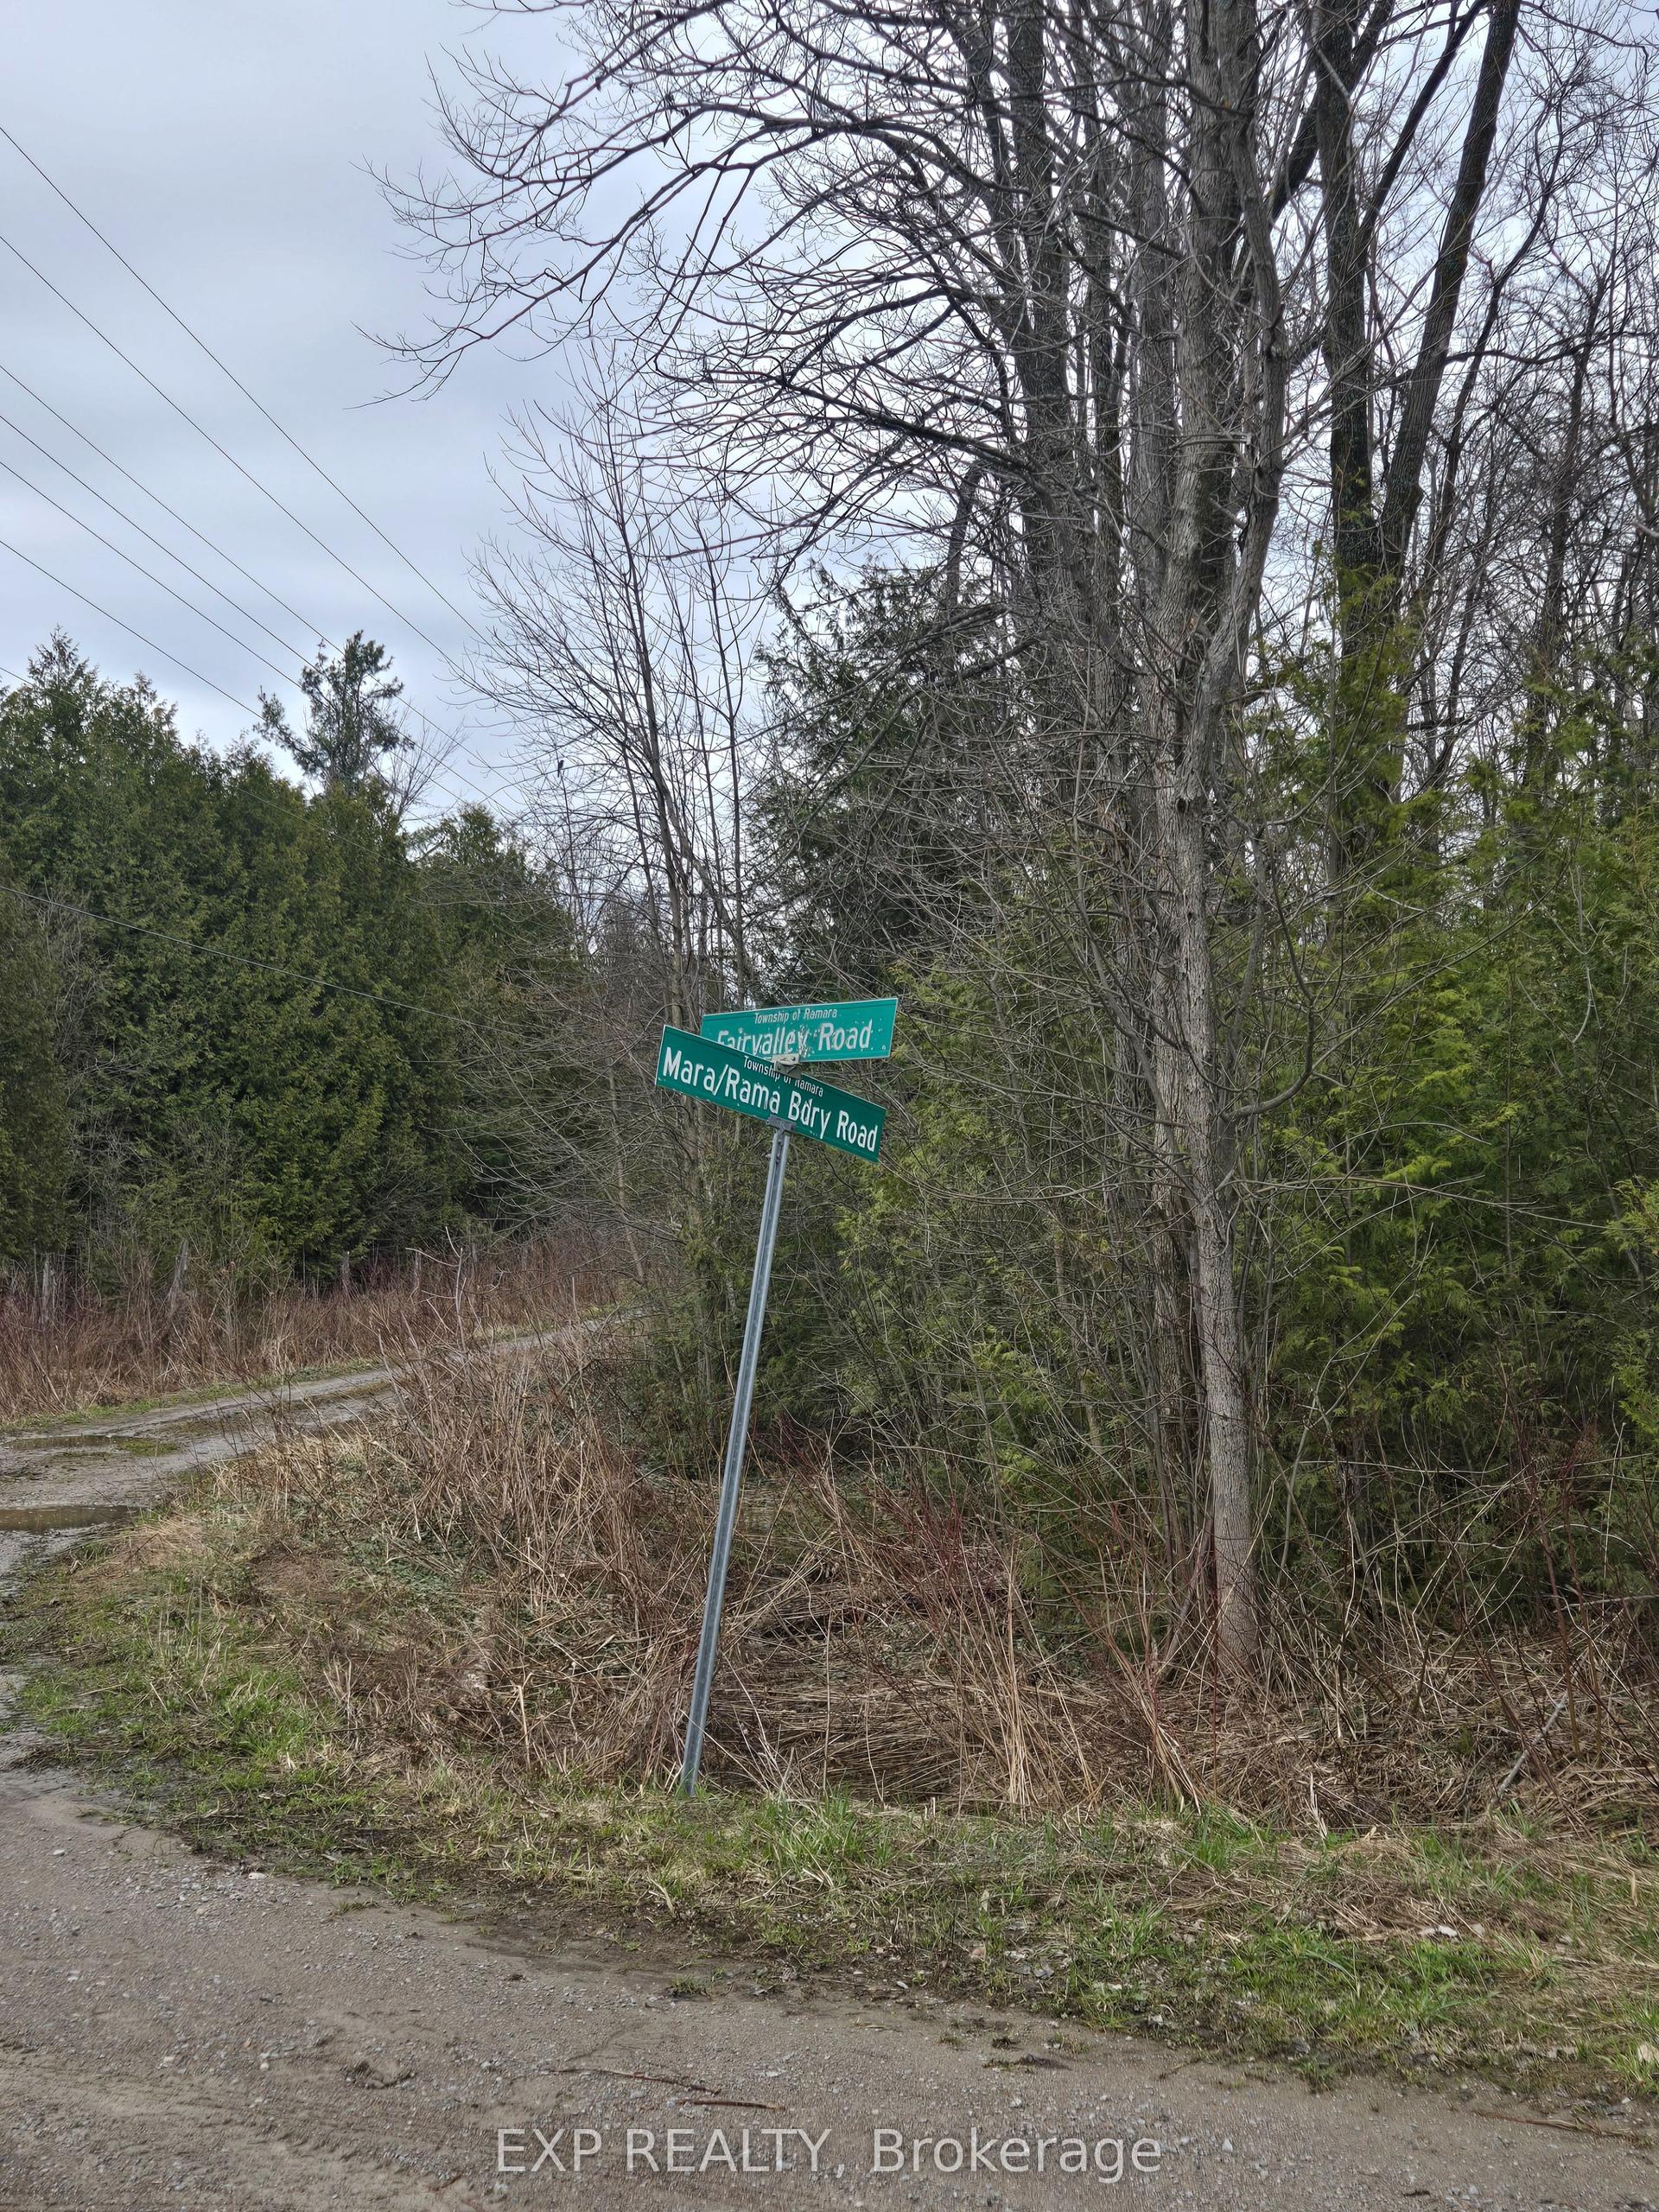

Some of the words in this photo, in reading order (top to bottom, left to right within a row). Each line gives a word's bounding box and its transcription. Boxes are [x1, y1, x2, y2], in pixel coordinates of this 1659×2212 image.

[754, 1010, 790, 1024] Township
[792, 1008, 801, 1020] of
[804, 1007, 838, 1020] Ramara
[818, 1019, 873, 1052] Road
[744, 1055, 781, 1083] Township
[663, 1046, 781, 1115] Mara/Rama
[787, 1090, 831, 1140] Bdry
[836, 1109, 878, 1153] Road
